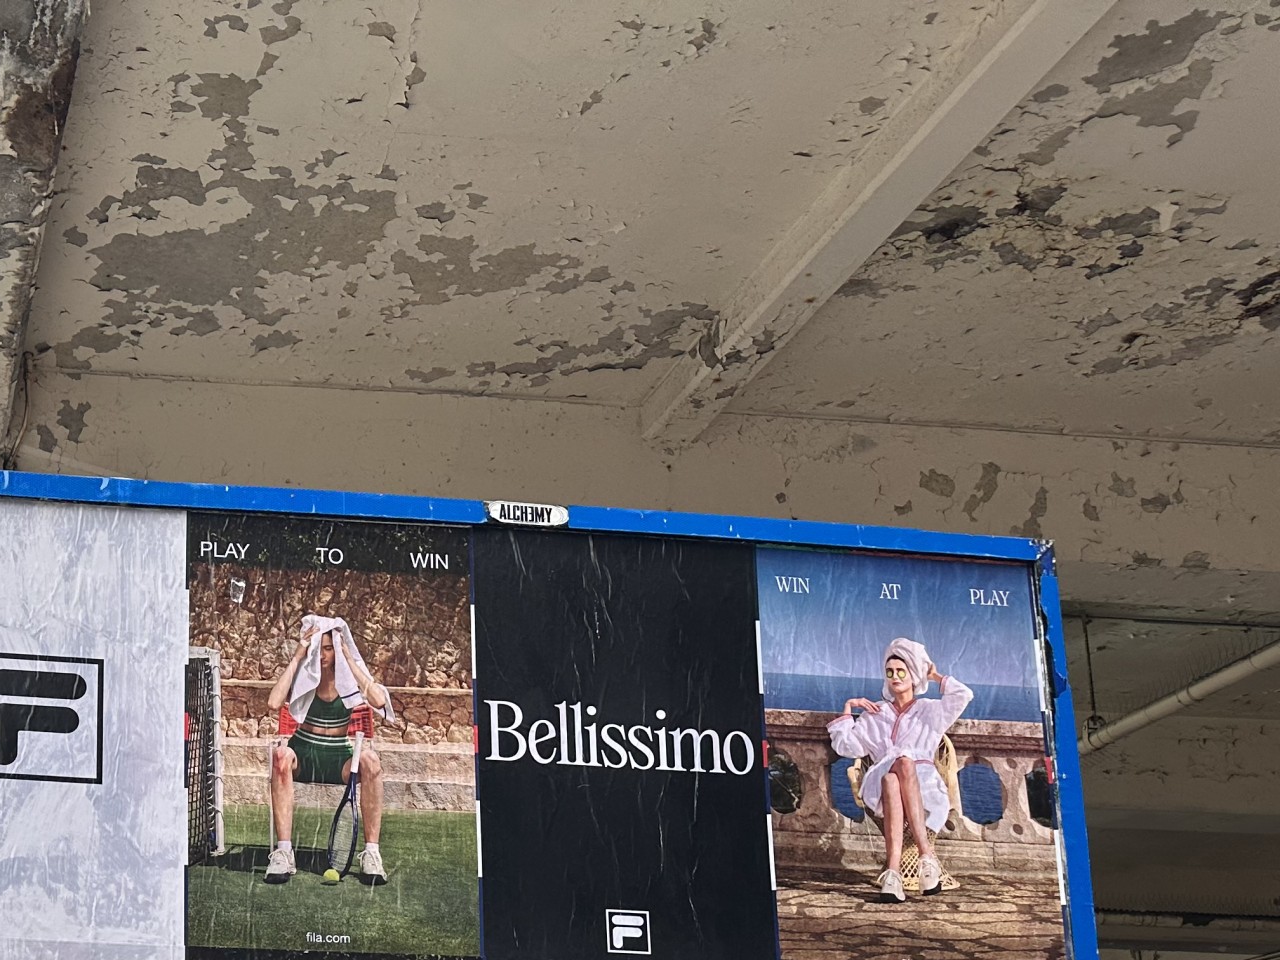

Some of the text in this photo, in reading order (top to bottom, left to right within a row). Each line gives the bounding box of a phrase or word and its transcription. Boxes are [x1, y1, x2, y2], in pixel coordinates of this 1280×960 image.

[199, 541, 449, 570] PLAY TO WIN
[774, 574, 1010, 608] WIN AT PLAY
[482, 699, 755, 777] Bellissimo
[305, 931, 351, 944] fila.com
